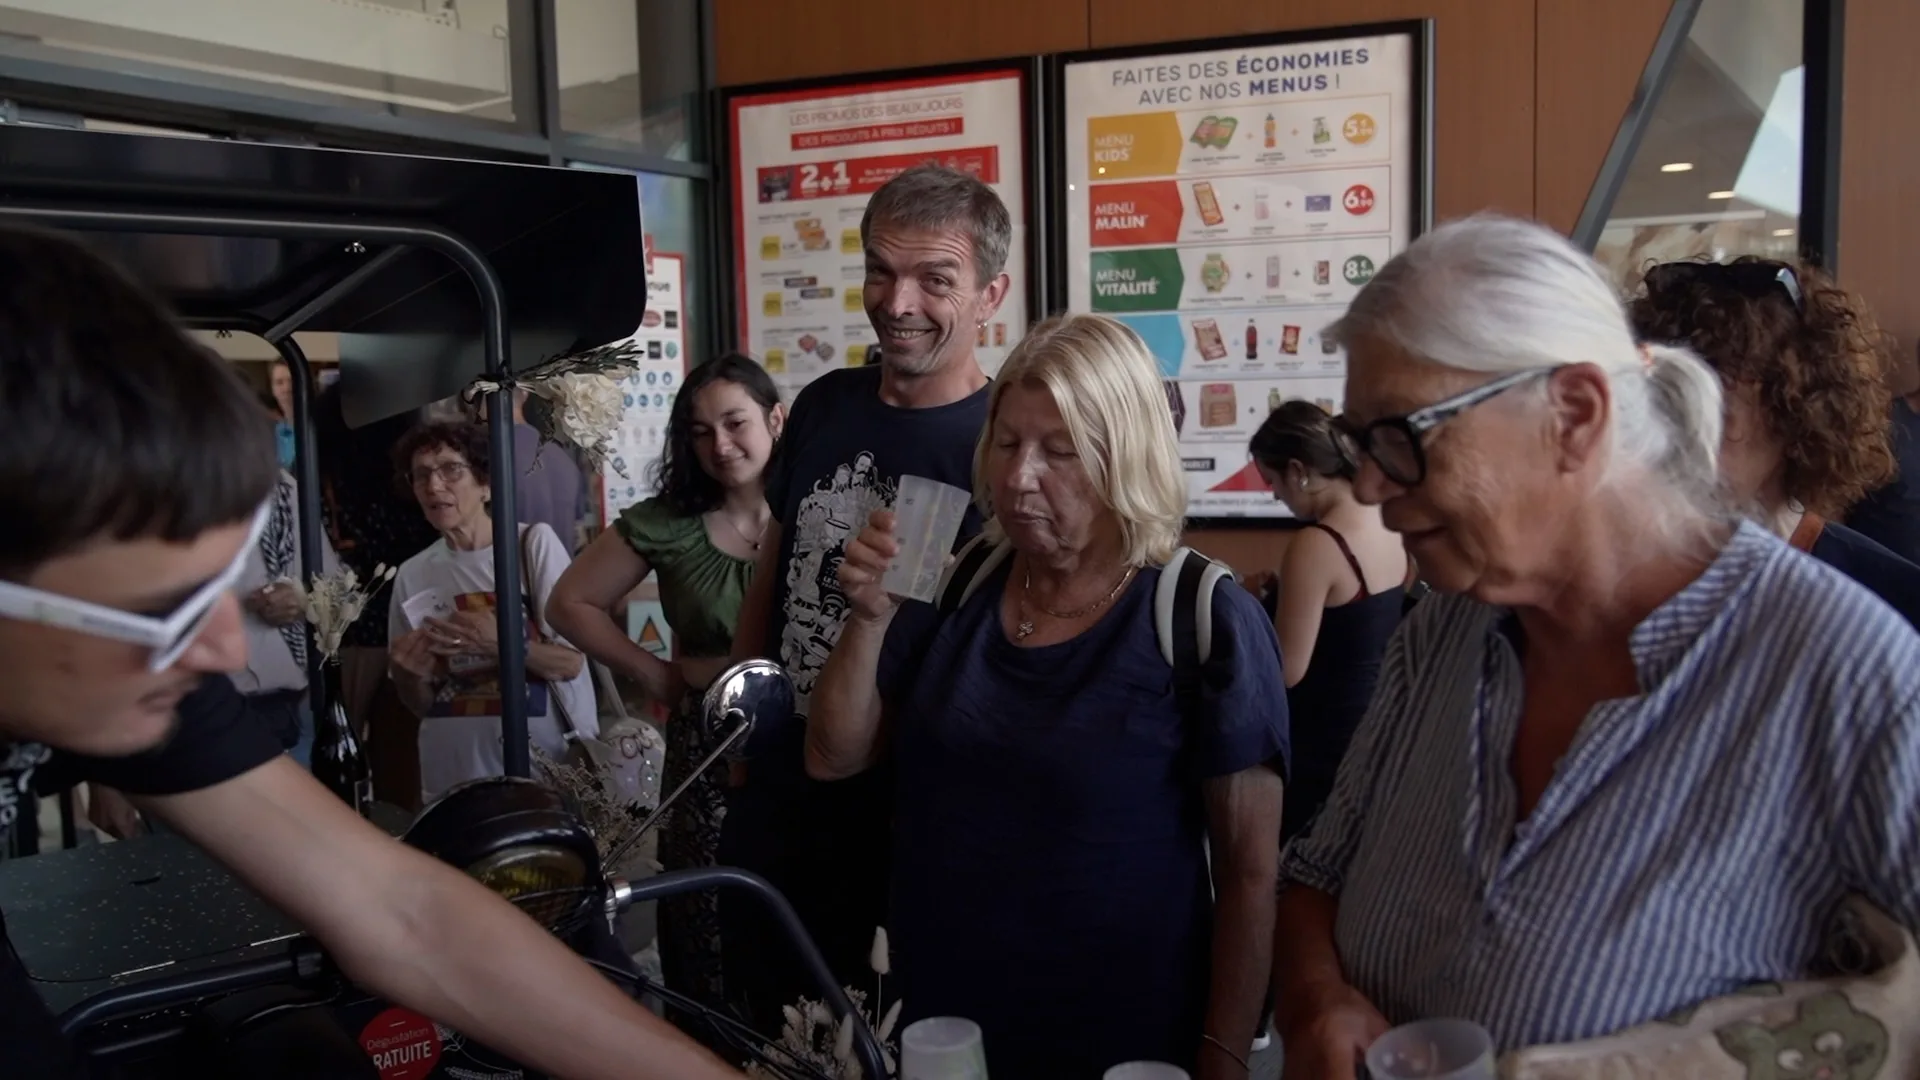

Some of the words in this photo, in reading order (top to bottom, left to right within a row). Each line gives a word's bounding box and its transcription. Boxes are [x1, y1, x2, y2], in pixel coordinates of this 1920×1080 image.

[1112, 65, 1181, 86] FAITES
[1188, 61, 1229, 80] DES
[1236, 48, 1370, 75] ÉCONOMIES
[1138, 86, 1192, 105] AVEC
[1200, 82, 1241, 101] NOS
[1249, 74, 1328, 96] MENUS
[1094, 134, 1134, 148] MENU
[1095, 202, 1135, 216] MENU
[1095, 268, 1136, 282] MENU
[373, 1040, 432, 1070] RATUITE
